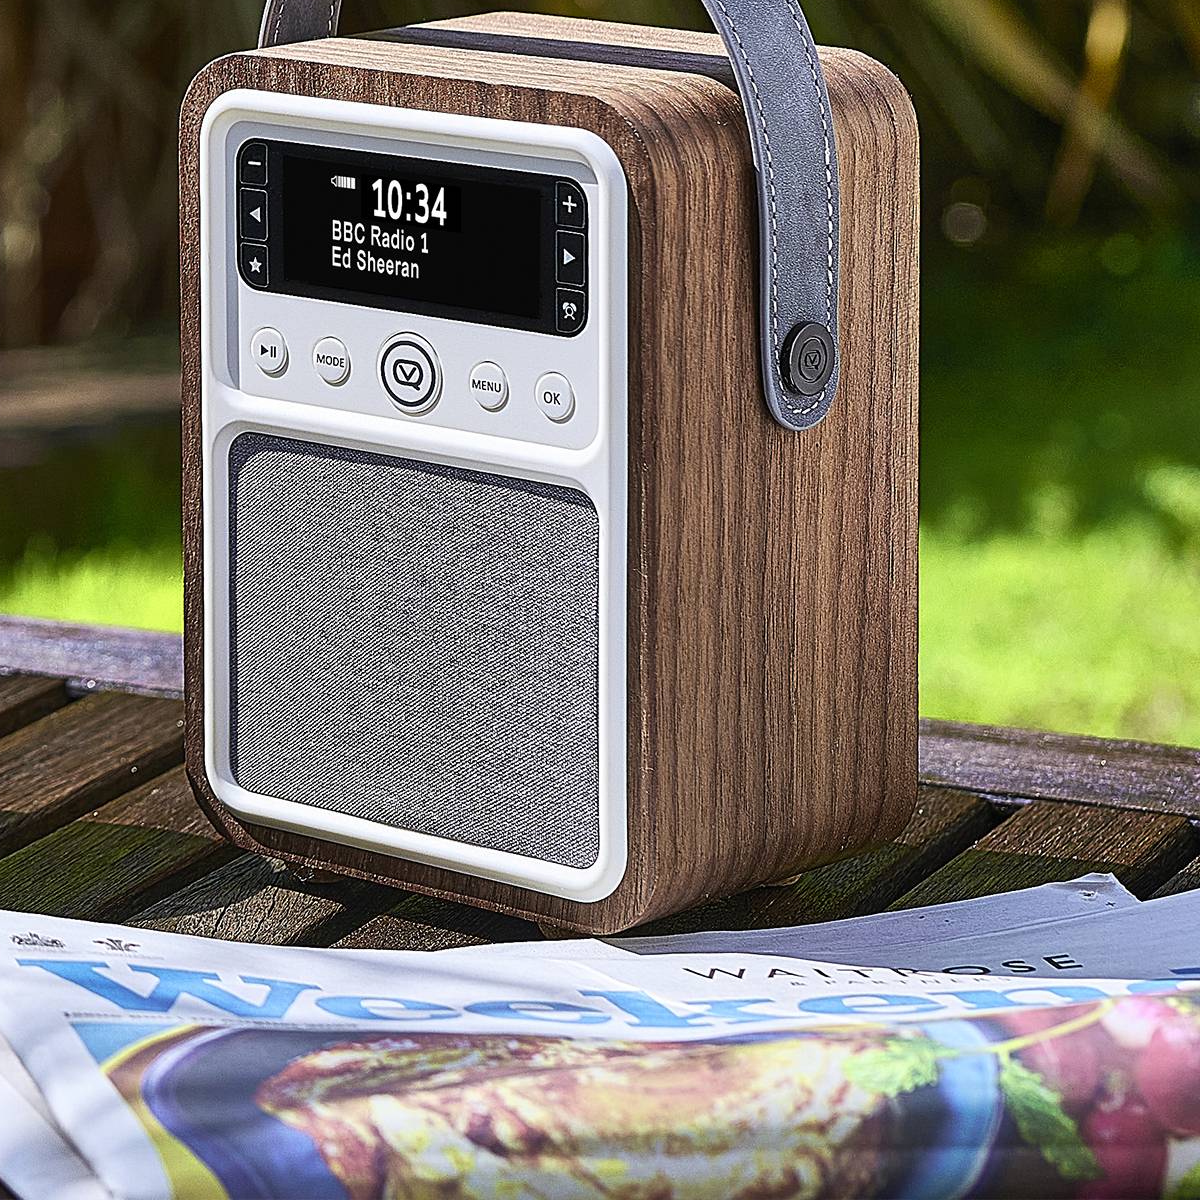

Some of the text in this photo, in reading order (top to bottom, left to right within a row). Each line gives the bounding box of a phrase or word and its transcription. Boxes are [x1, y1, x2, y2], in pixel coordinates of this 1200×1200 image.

[372, 178, 447, 226] 10:34
[332, 219, 429, 254] BBC Radio 1
[331, 245, 419, 279] Ed Sheeran
[316, 352, 345, 369] MODE
[471, 378, 502, 394] MENU
[543, 391, 561, 406] OK
[682, 954, 1083, 980] WAITROSE
